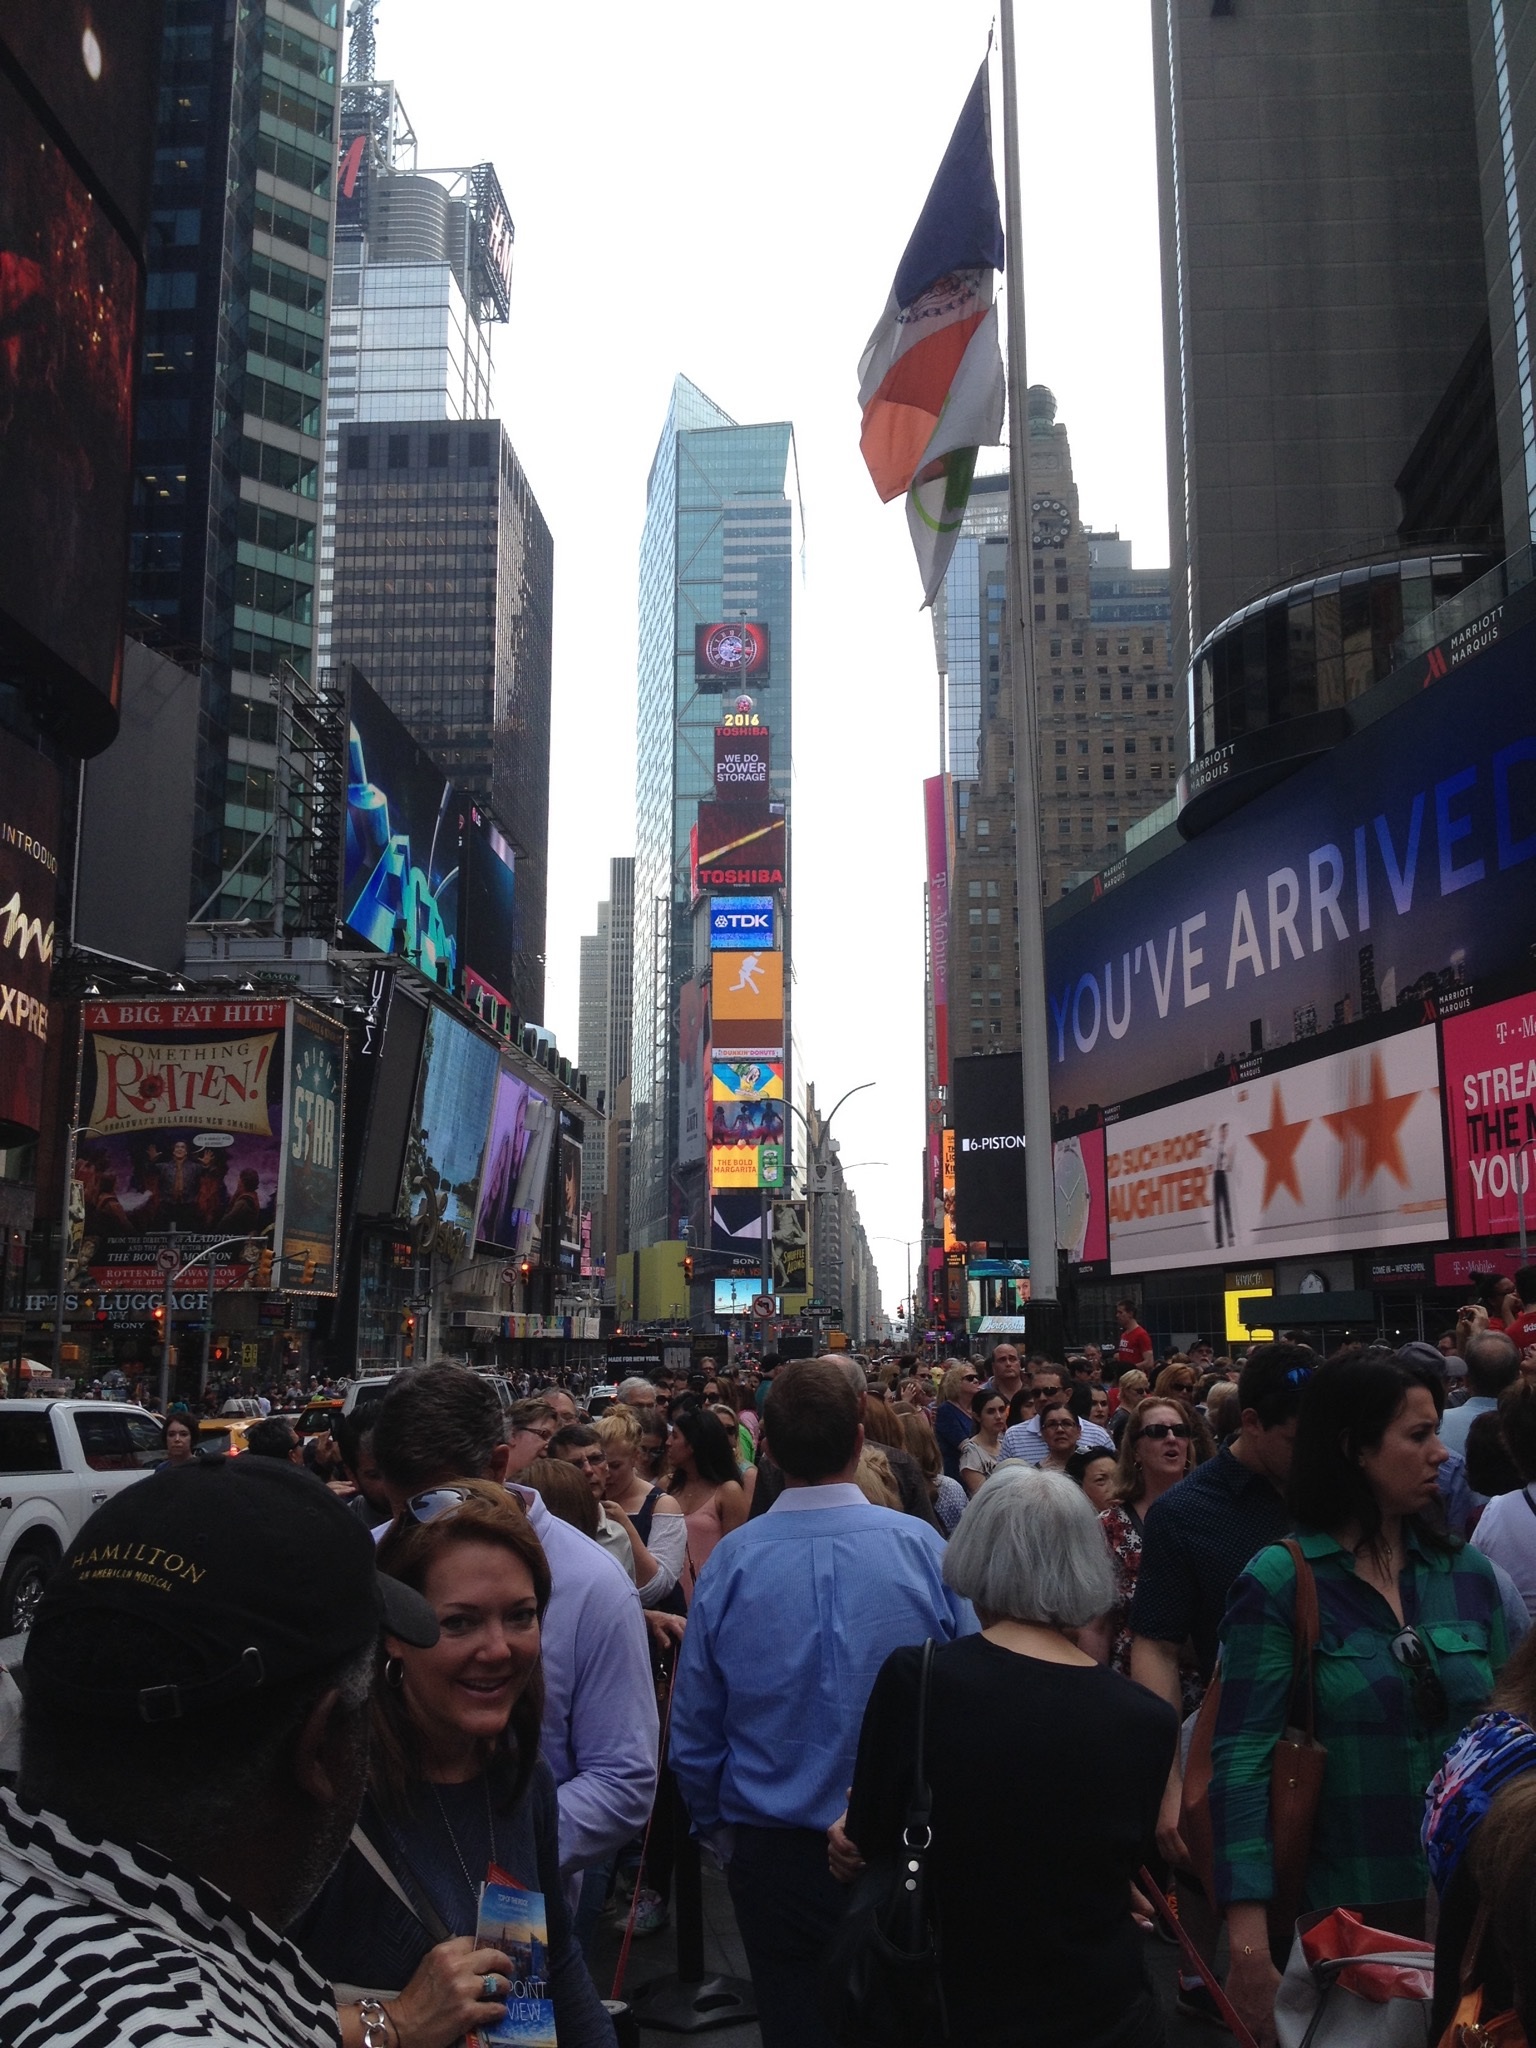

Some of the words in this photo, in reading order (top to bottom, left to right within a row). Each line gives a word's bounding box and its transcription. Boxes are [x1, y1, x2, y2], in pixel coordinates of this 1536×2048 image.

[1450, 605, 1504, 648] MARRIOTT
[1451, 627, 1499, 665] MARQUIS
[724, 714, 760, 726] 2016
[715, 727, 769, 736] TOSHIBA
[724, 754, 741, 763] WE
[744, 753, 759, 762] DO
[1190, 743, 1235, 776] MARRIOTT
[716, 763, 767, 773] POWER
[716, 773, 766, 782] STORAGE
[1190, 762, 1229, 793] MARQUIS
[700, 869, 784, 884] TOSHIBA
[1103, 857, 1128, 879] MARRIOTT
[1104, 871, 1126, 890] MARQUIS
[1049, 911, 1210, 1062] YOU'VE
[1226, 735, 1536, 990] ARRIVED
[727, 915, 769, 928] TDK
[260, 972, 296, 981] LAMAR
[1438, 986, 1474, 1004] MARRIOTT
[172, 1006, 217, 1023] FAT
[1439, 999, 1470, 1015] MARQUIS
[119, 1043, 249, 1061] SOMETHING
[1239, 1057, 1262, 1070] MARRIOTT
[1239, 1066, 1261, 1079] MARQUIS
[104, 1117, 154, 1132] BROADWAY'S
[158, 1116, 203, 1125] HILARIOUS
[206, 1116, 223, 1125] NEW
[292, 1085, 335, 1169] STAR
[1467, 1105, 1521, 1154] THE
[970, 1135, 1026, 1151] 6-PISTON
[1469, 1150, 1529, 1199] YOU
[107, 1236, 126, 1244] FROM
[128, 1236, 142, 1244] THE
[185, 1234, 233, 1243] ALADDIN
[107, 1253, 130, 1261] THE
[132, 1253, 158, 1261] BOO
[182, 1252, 232, 1261] MORON
[1372, 1265, 1385, 1274] COME
[100, 1293, 209, 1312] LUGGAGE
[107, 1312, 128, 1321] NY
[245, 1344, 253, 1364] ATM
[71, 1543, 207, 1584] HAMILTON
[92, 1568, 133, 1579] AMERICAN
[134, 1572, 173, 1592] MUSICAL
[506, 2002, 541, 2021] VIEW
